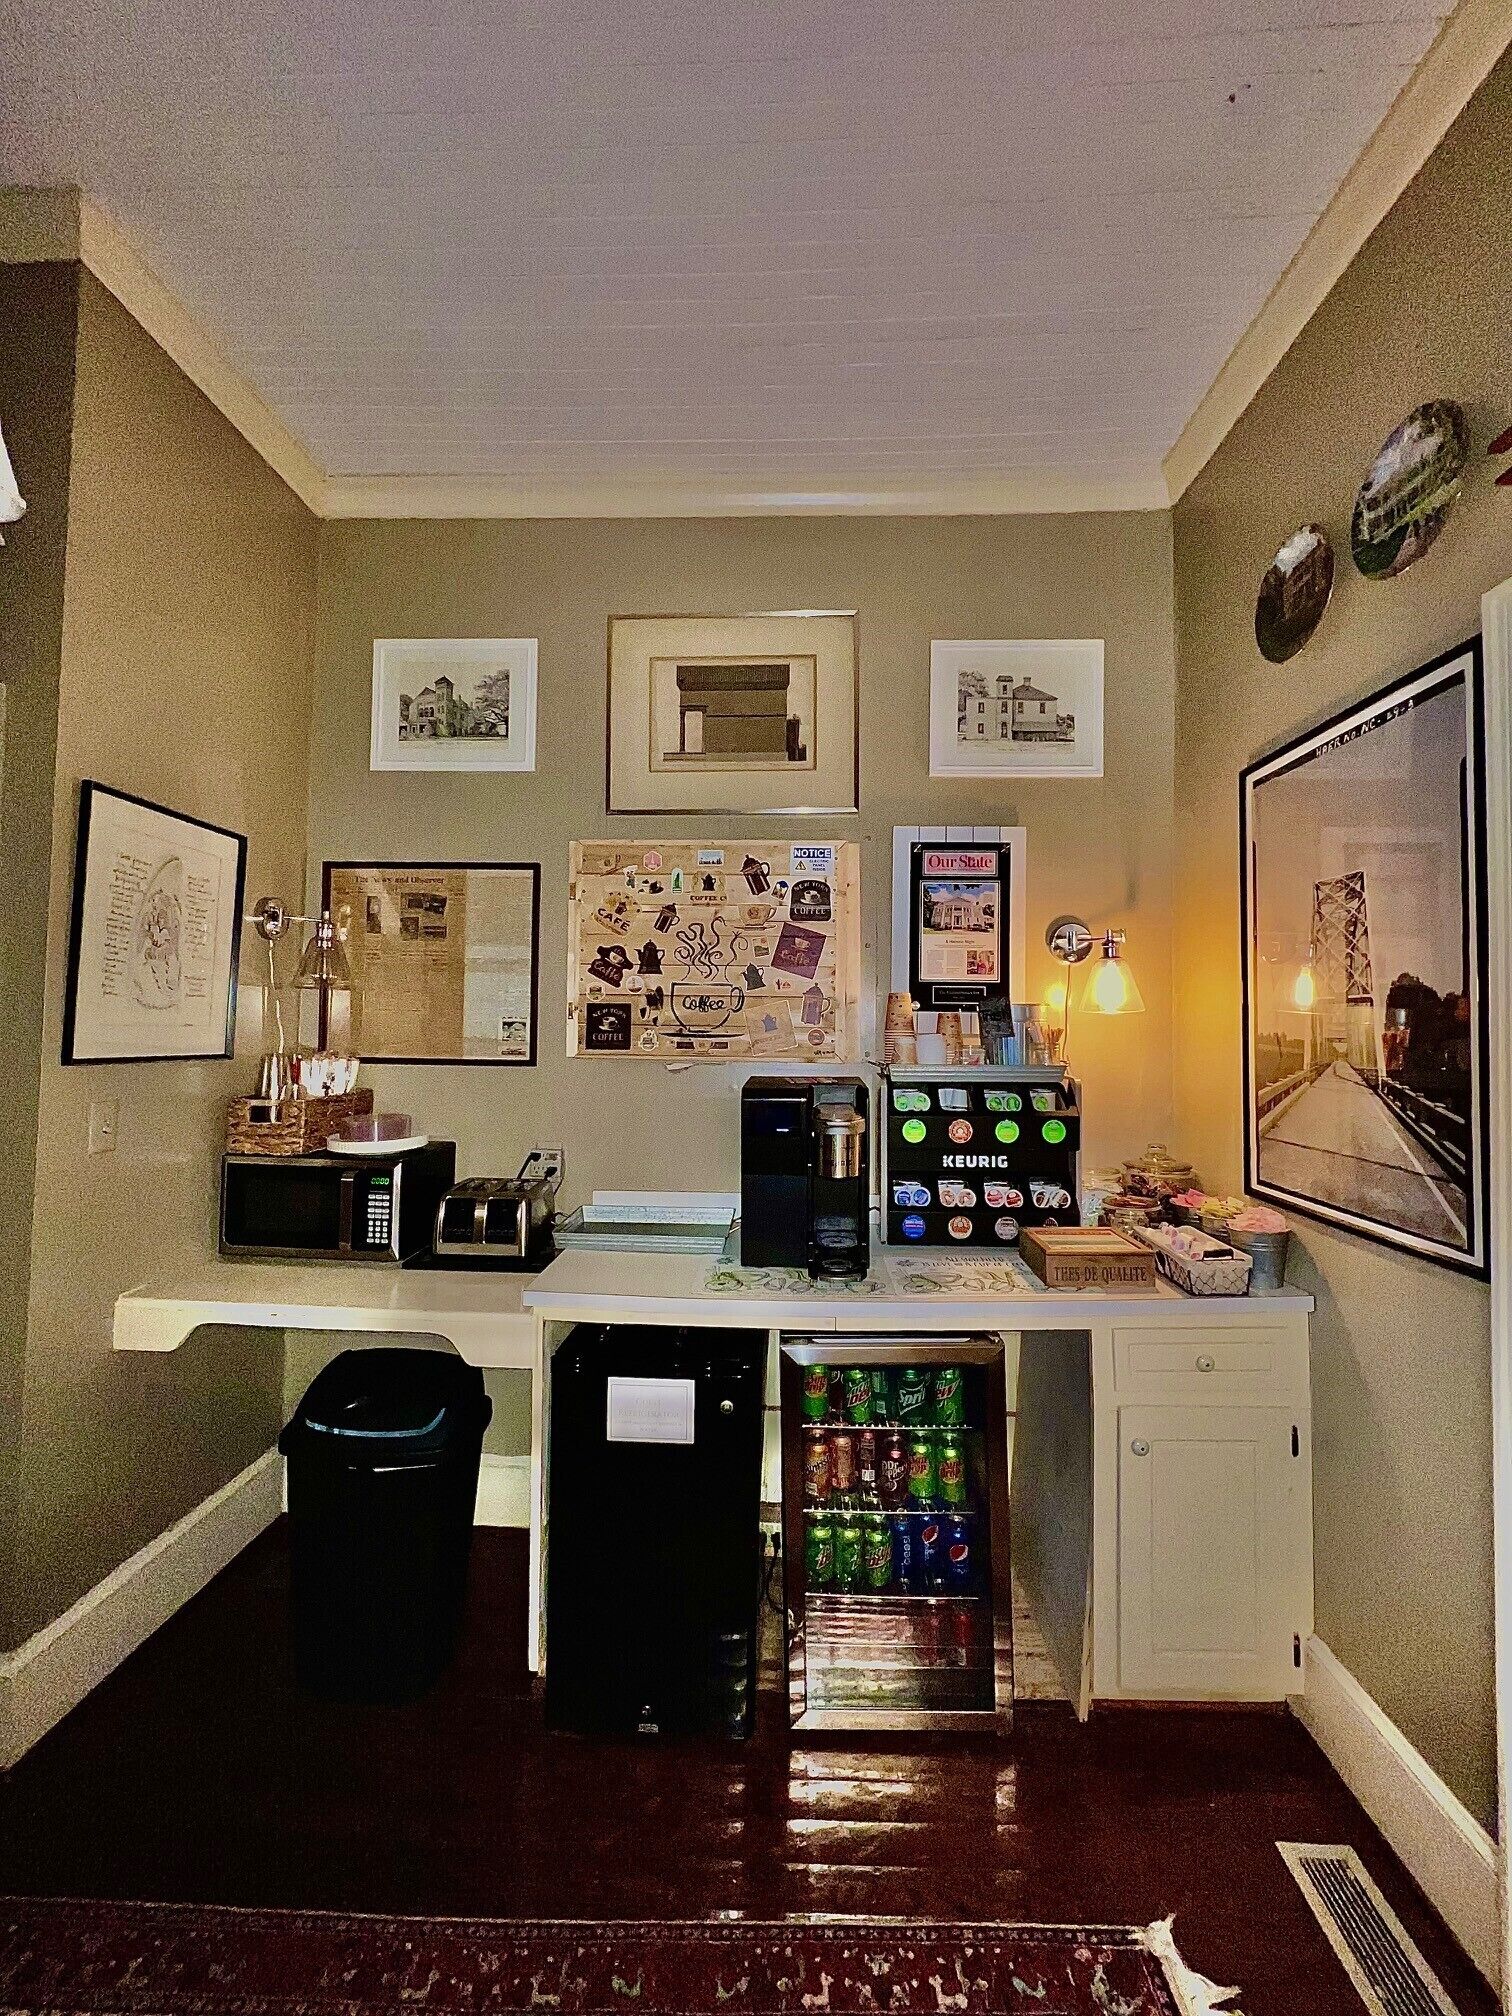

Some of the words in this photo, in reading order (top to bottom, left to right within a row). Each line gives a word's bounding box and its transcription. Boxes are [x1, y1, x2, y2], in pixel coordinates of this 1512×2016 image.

[794, 849, 831, 858] NOTICE
[928, 854, 958, 868] Our
[959, 854, 993, 868] State
[794, 907, 827, 915] COFFEE
[682, 995, 728, 1013] Coffee
[592, 1033, 624, 1041] COFFEE
[942, 1154, 1008, 1168] KEURIG
[1084, 1266, 1099, 1281] DE
